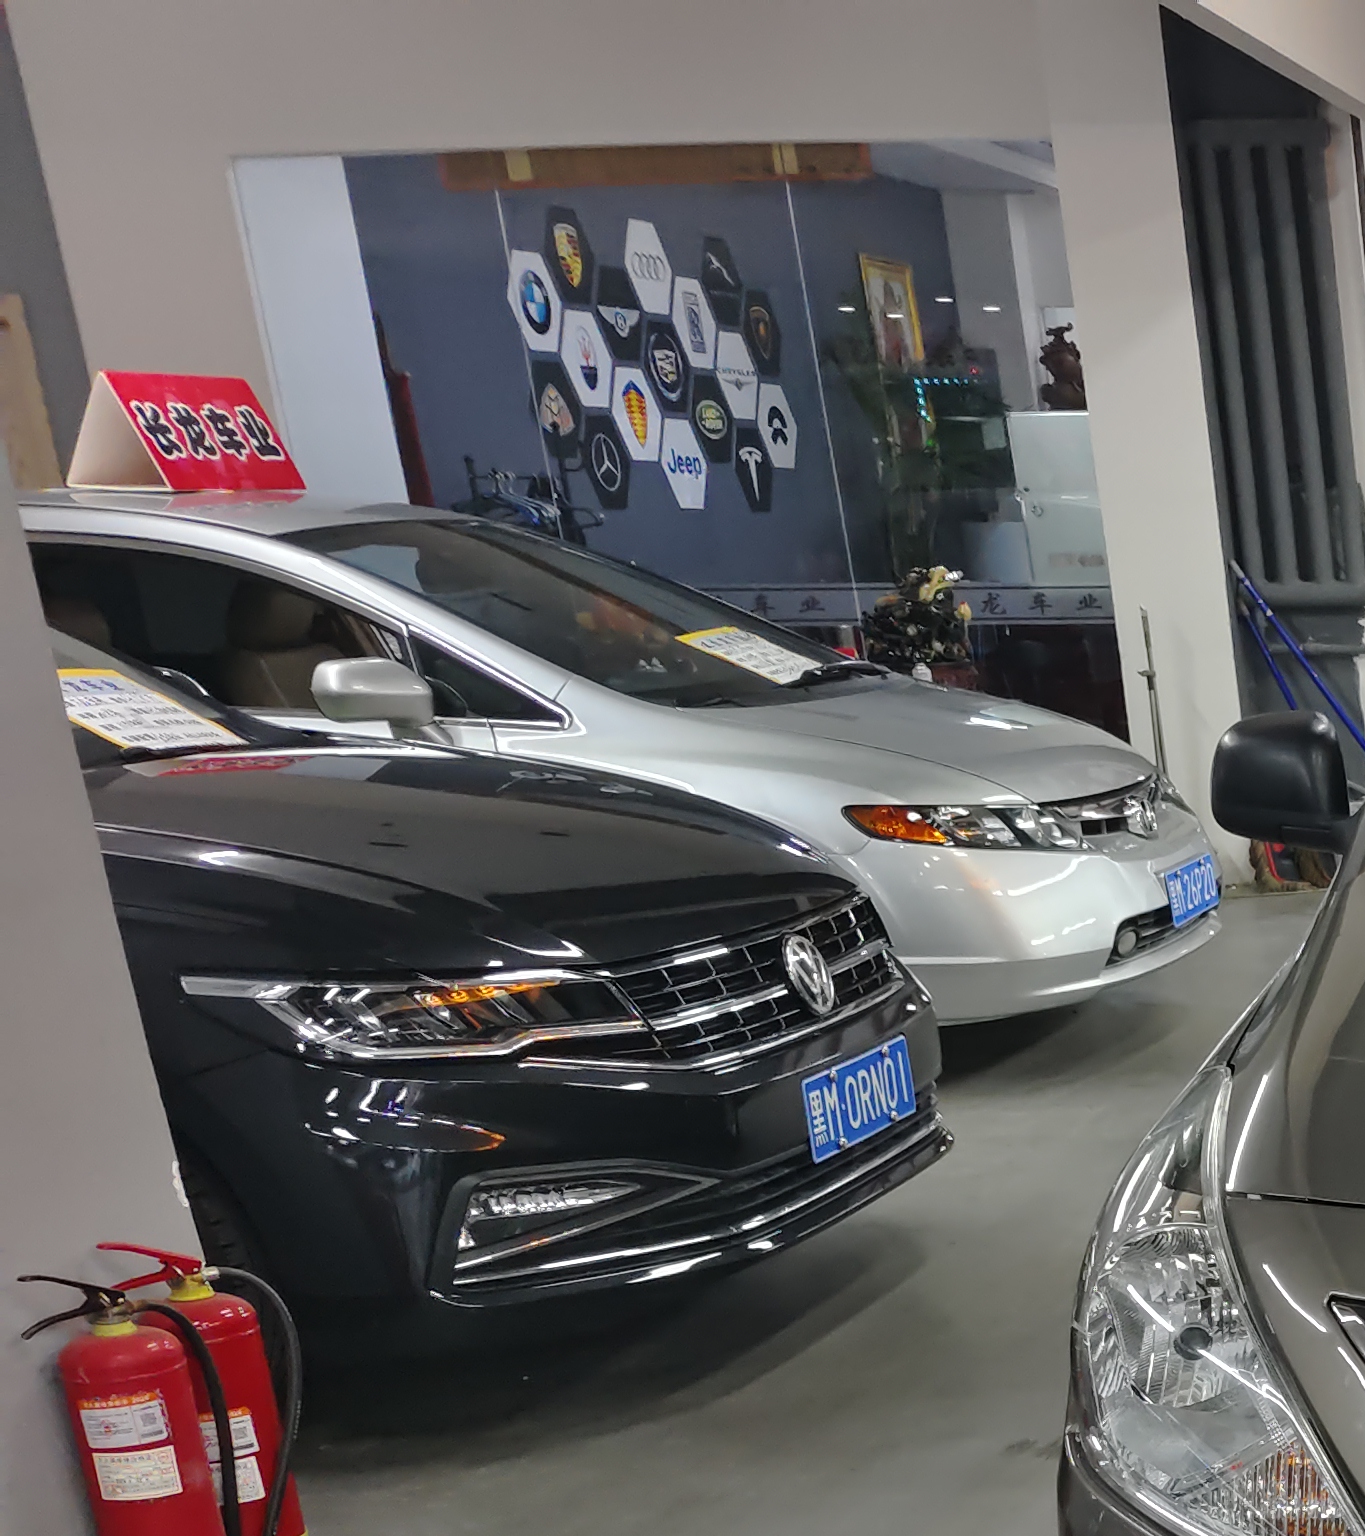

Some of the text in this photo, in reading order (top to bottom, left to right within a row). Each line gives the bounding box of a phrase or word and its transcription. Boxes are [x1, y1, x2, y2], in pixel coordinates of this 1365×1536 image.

[129, 400, 286, 461] 长龙车业
[667, 448, 703, 479] Jeep
